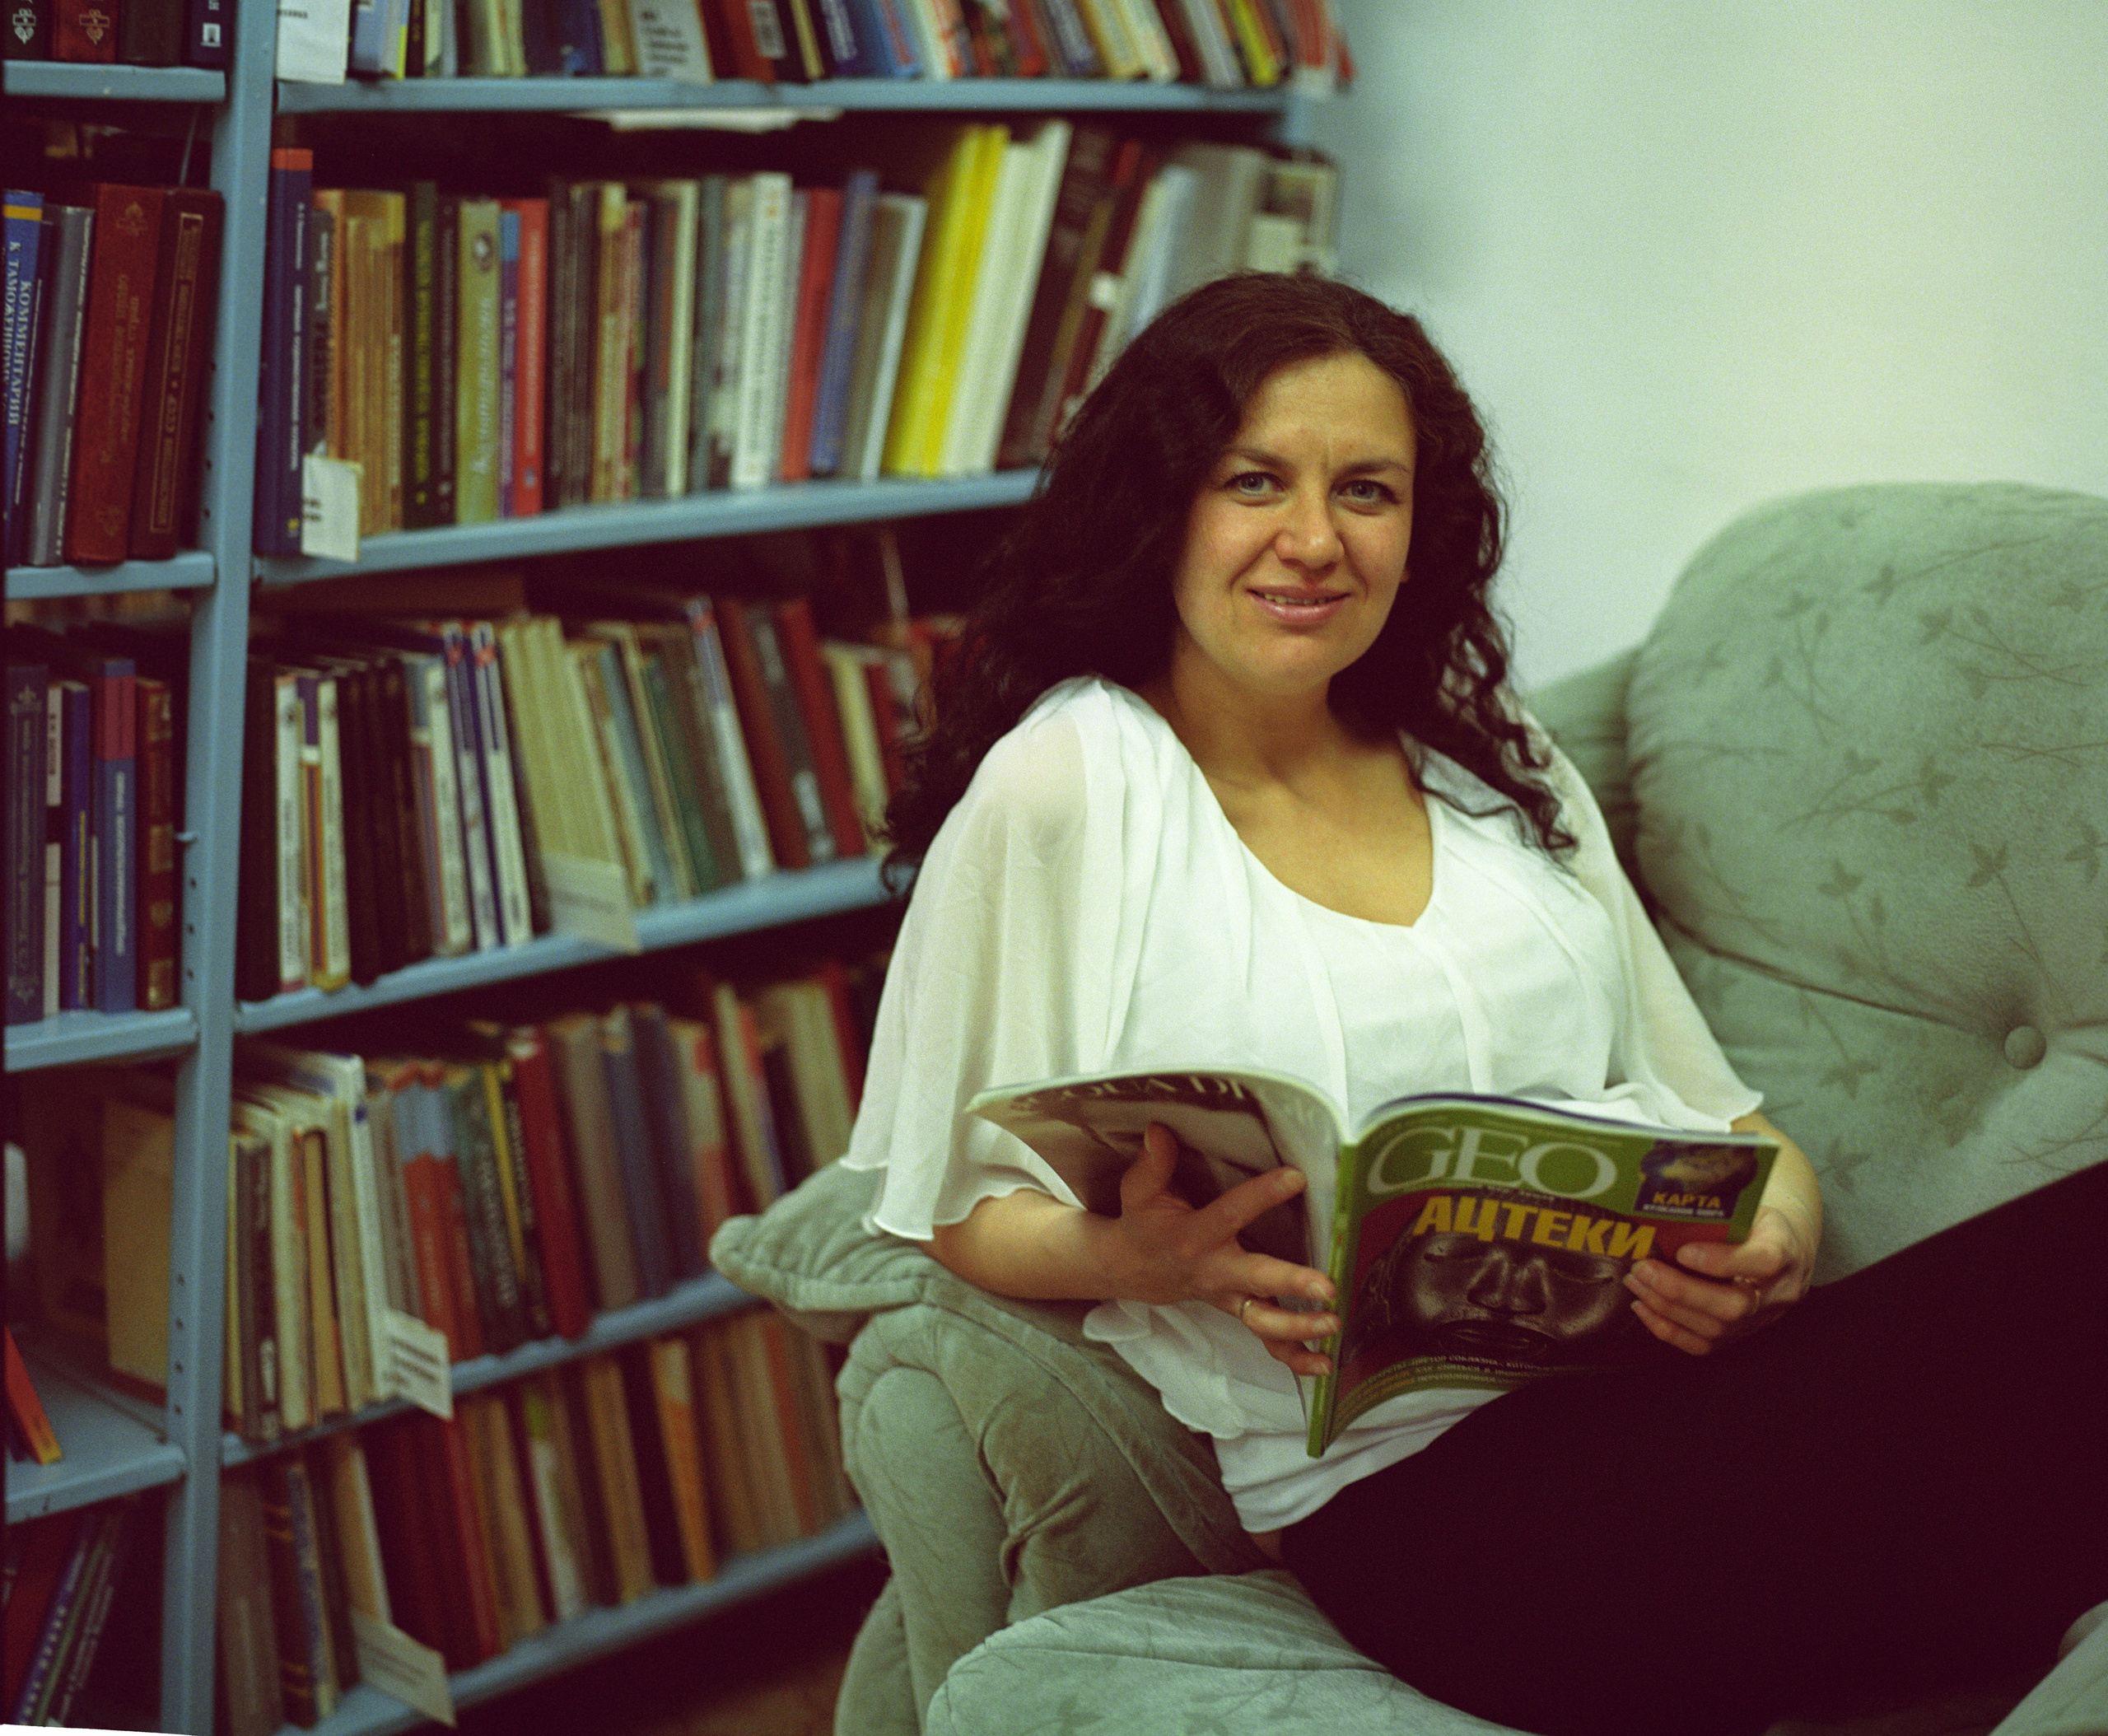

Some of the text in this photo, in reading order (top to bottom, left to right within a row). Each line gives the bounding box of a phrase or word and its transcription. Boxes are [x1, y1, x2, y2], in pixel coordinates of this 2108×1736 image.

[10, 241, 21, 252] К
[8, 281, 32, 425] КОММЕНТАРИЙ
[1367, 1126, 1617, 1198] GEO
[1412, 1196, 1656, 1260] АЦТЕКИ
[1653, 1191, 1721, 1209] КАРТА
